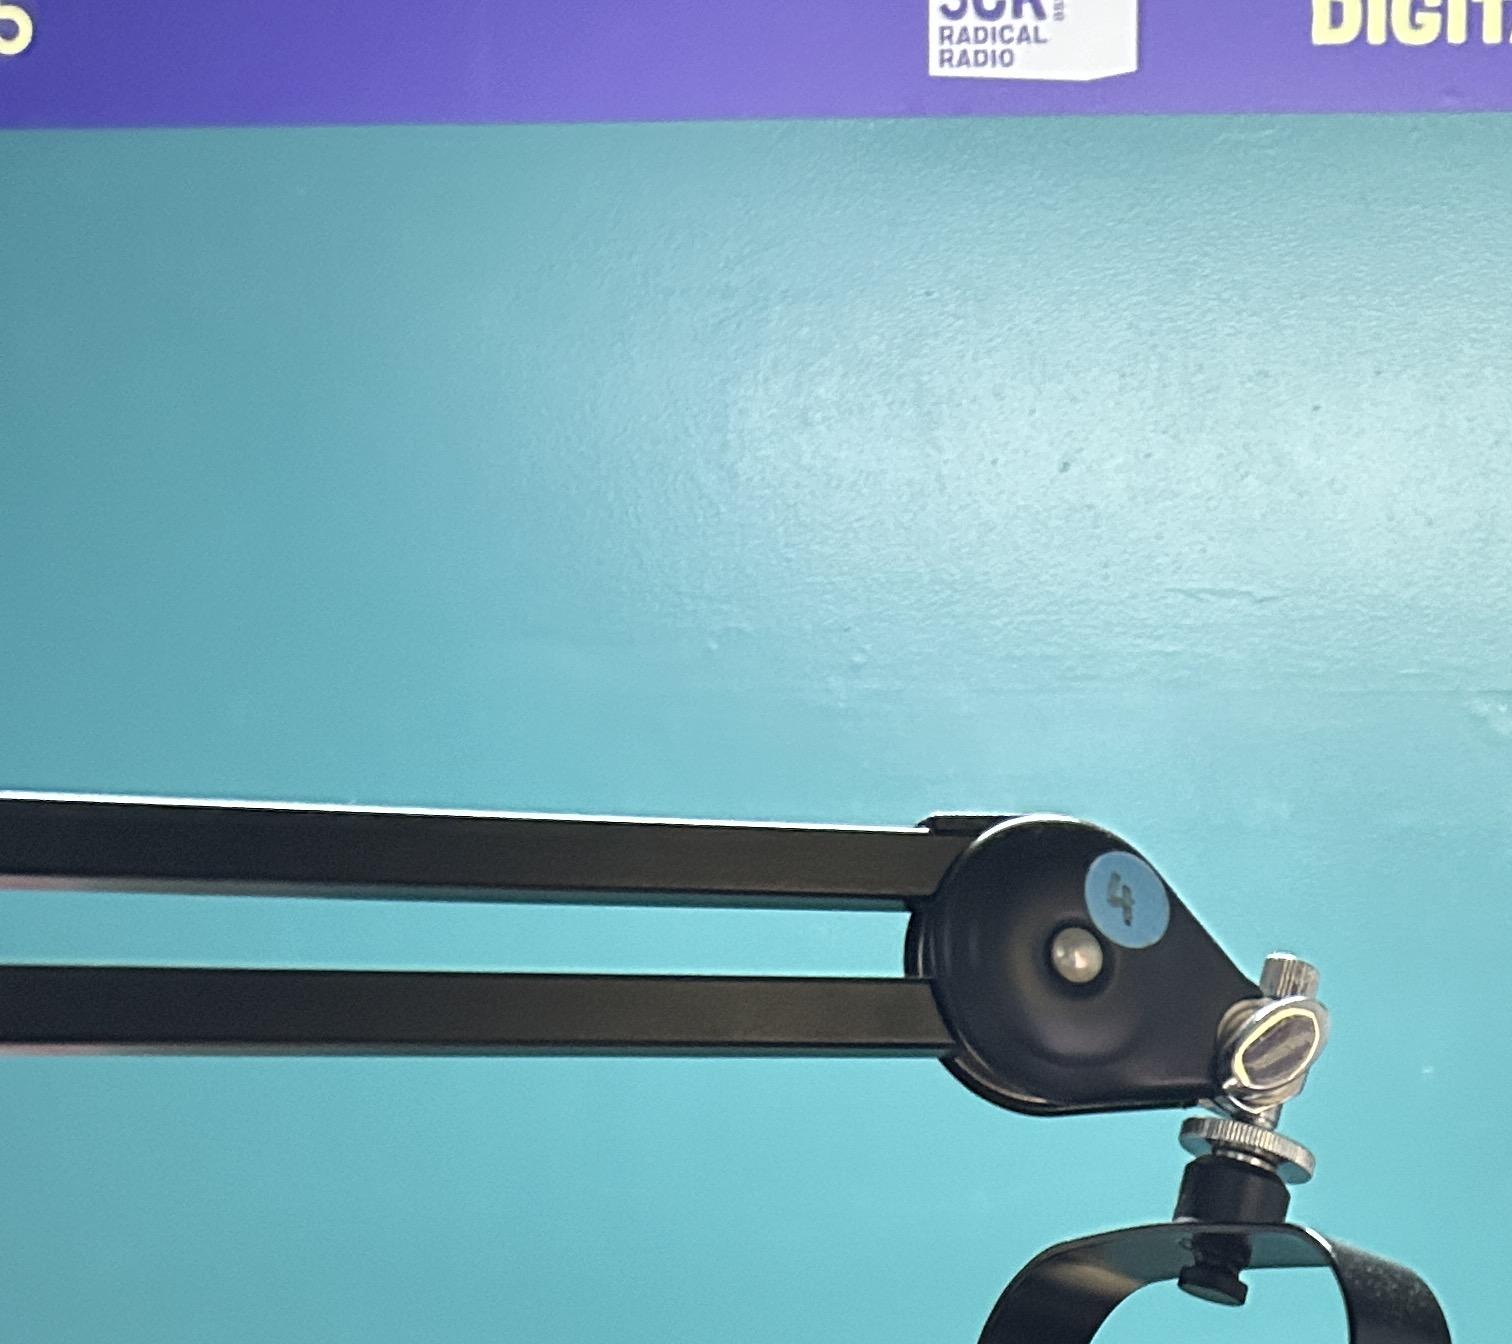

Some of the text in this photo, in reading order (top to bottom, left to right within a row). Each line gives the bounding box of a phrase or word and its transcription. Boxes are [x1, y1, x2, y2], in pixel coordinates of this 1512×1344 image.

[939, 25, 1048, 45] RADICAL
[939, 48, 1015, 68] RADIO
[1106, 873, 1135, 927] 4
